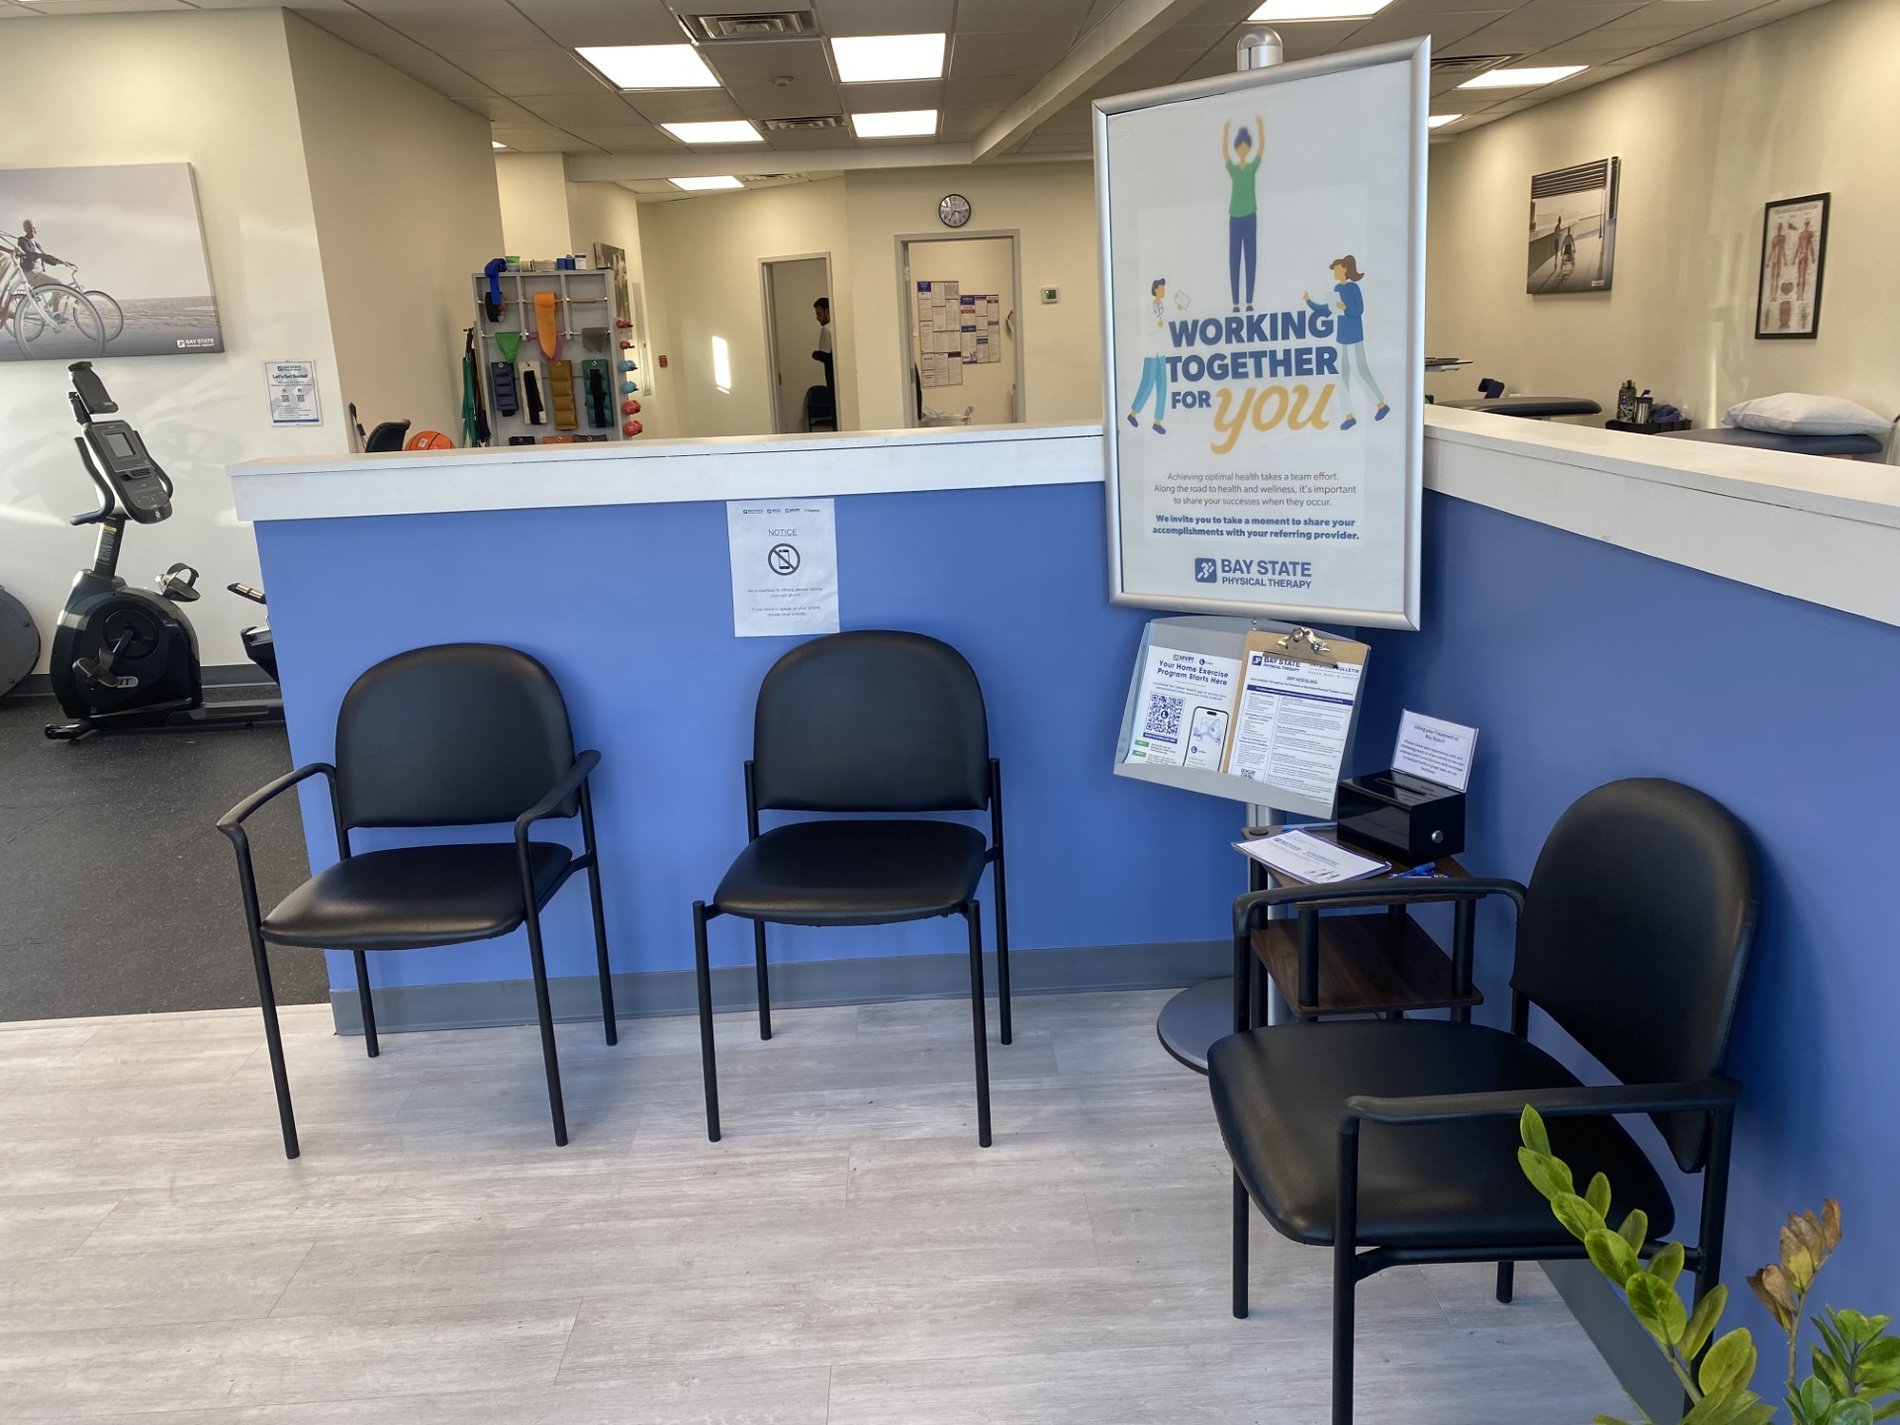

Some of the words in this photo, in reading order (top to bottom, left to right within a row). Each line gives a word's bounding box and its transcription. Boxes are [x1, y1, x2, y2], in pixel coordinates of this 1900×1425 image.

[1168, 310, 1334, 348] WORKING
[1166, 346, 1339, 383] TOGETHER
[1171, 390, 1212, 409] FOR
[1210, 384, 1335, 454] you
[1168, 472, 1203, 482] Achieving
[1205, 472, 1233, 482] optimal
[1235, 472, 1259, 480] health
[1261, 472, 1282, 480] takes
[1313, 472, 1339, 481] effort.
[1154, 485, 1175, 494] Along
[1218, 485, 1241, 493] health
[1244, 485, 1258, 493] and
[1260, 486, 1297, 494] wellness,
[1300, 485, 1312, 493] it's
[1314, 486, 1356, 495] important
[1286, 498, 1304, 507] they
[1170, 515, 1193, 523] invite
[1195, 517, 1211, 525] you
[1303, 518, 1330, 526] share
[1332, 519, 1355, 528] your
[1153, 527, 1224, 536] accomplishments
[1226, 527, 1245, 536] with
[1247, 530, 1268, 538] your
[1270, 529, 1312, 540] referring
[1314, 530, 1359, 540] provider.
[1220, 558, 1253, 574] BAY
[1257, 560, 1312, 577] STATE
[1222, 576, 1267, 586] PHYSICAL
[1268, 579, 1312, 589] THERAPY
[1160, 660, 1175, 668] Your
[1176, 663, 1197, 672] Home
[1199, 667, 1228, 678] Exercise
[1278, 659, 1300, 667] STATE
[1157, 667, 1187, 678] Program
[1189, 673, 1209, 683] Starts
